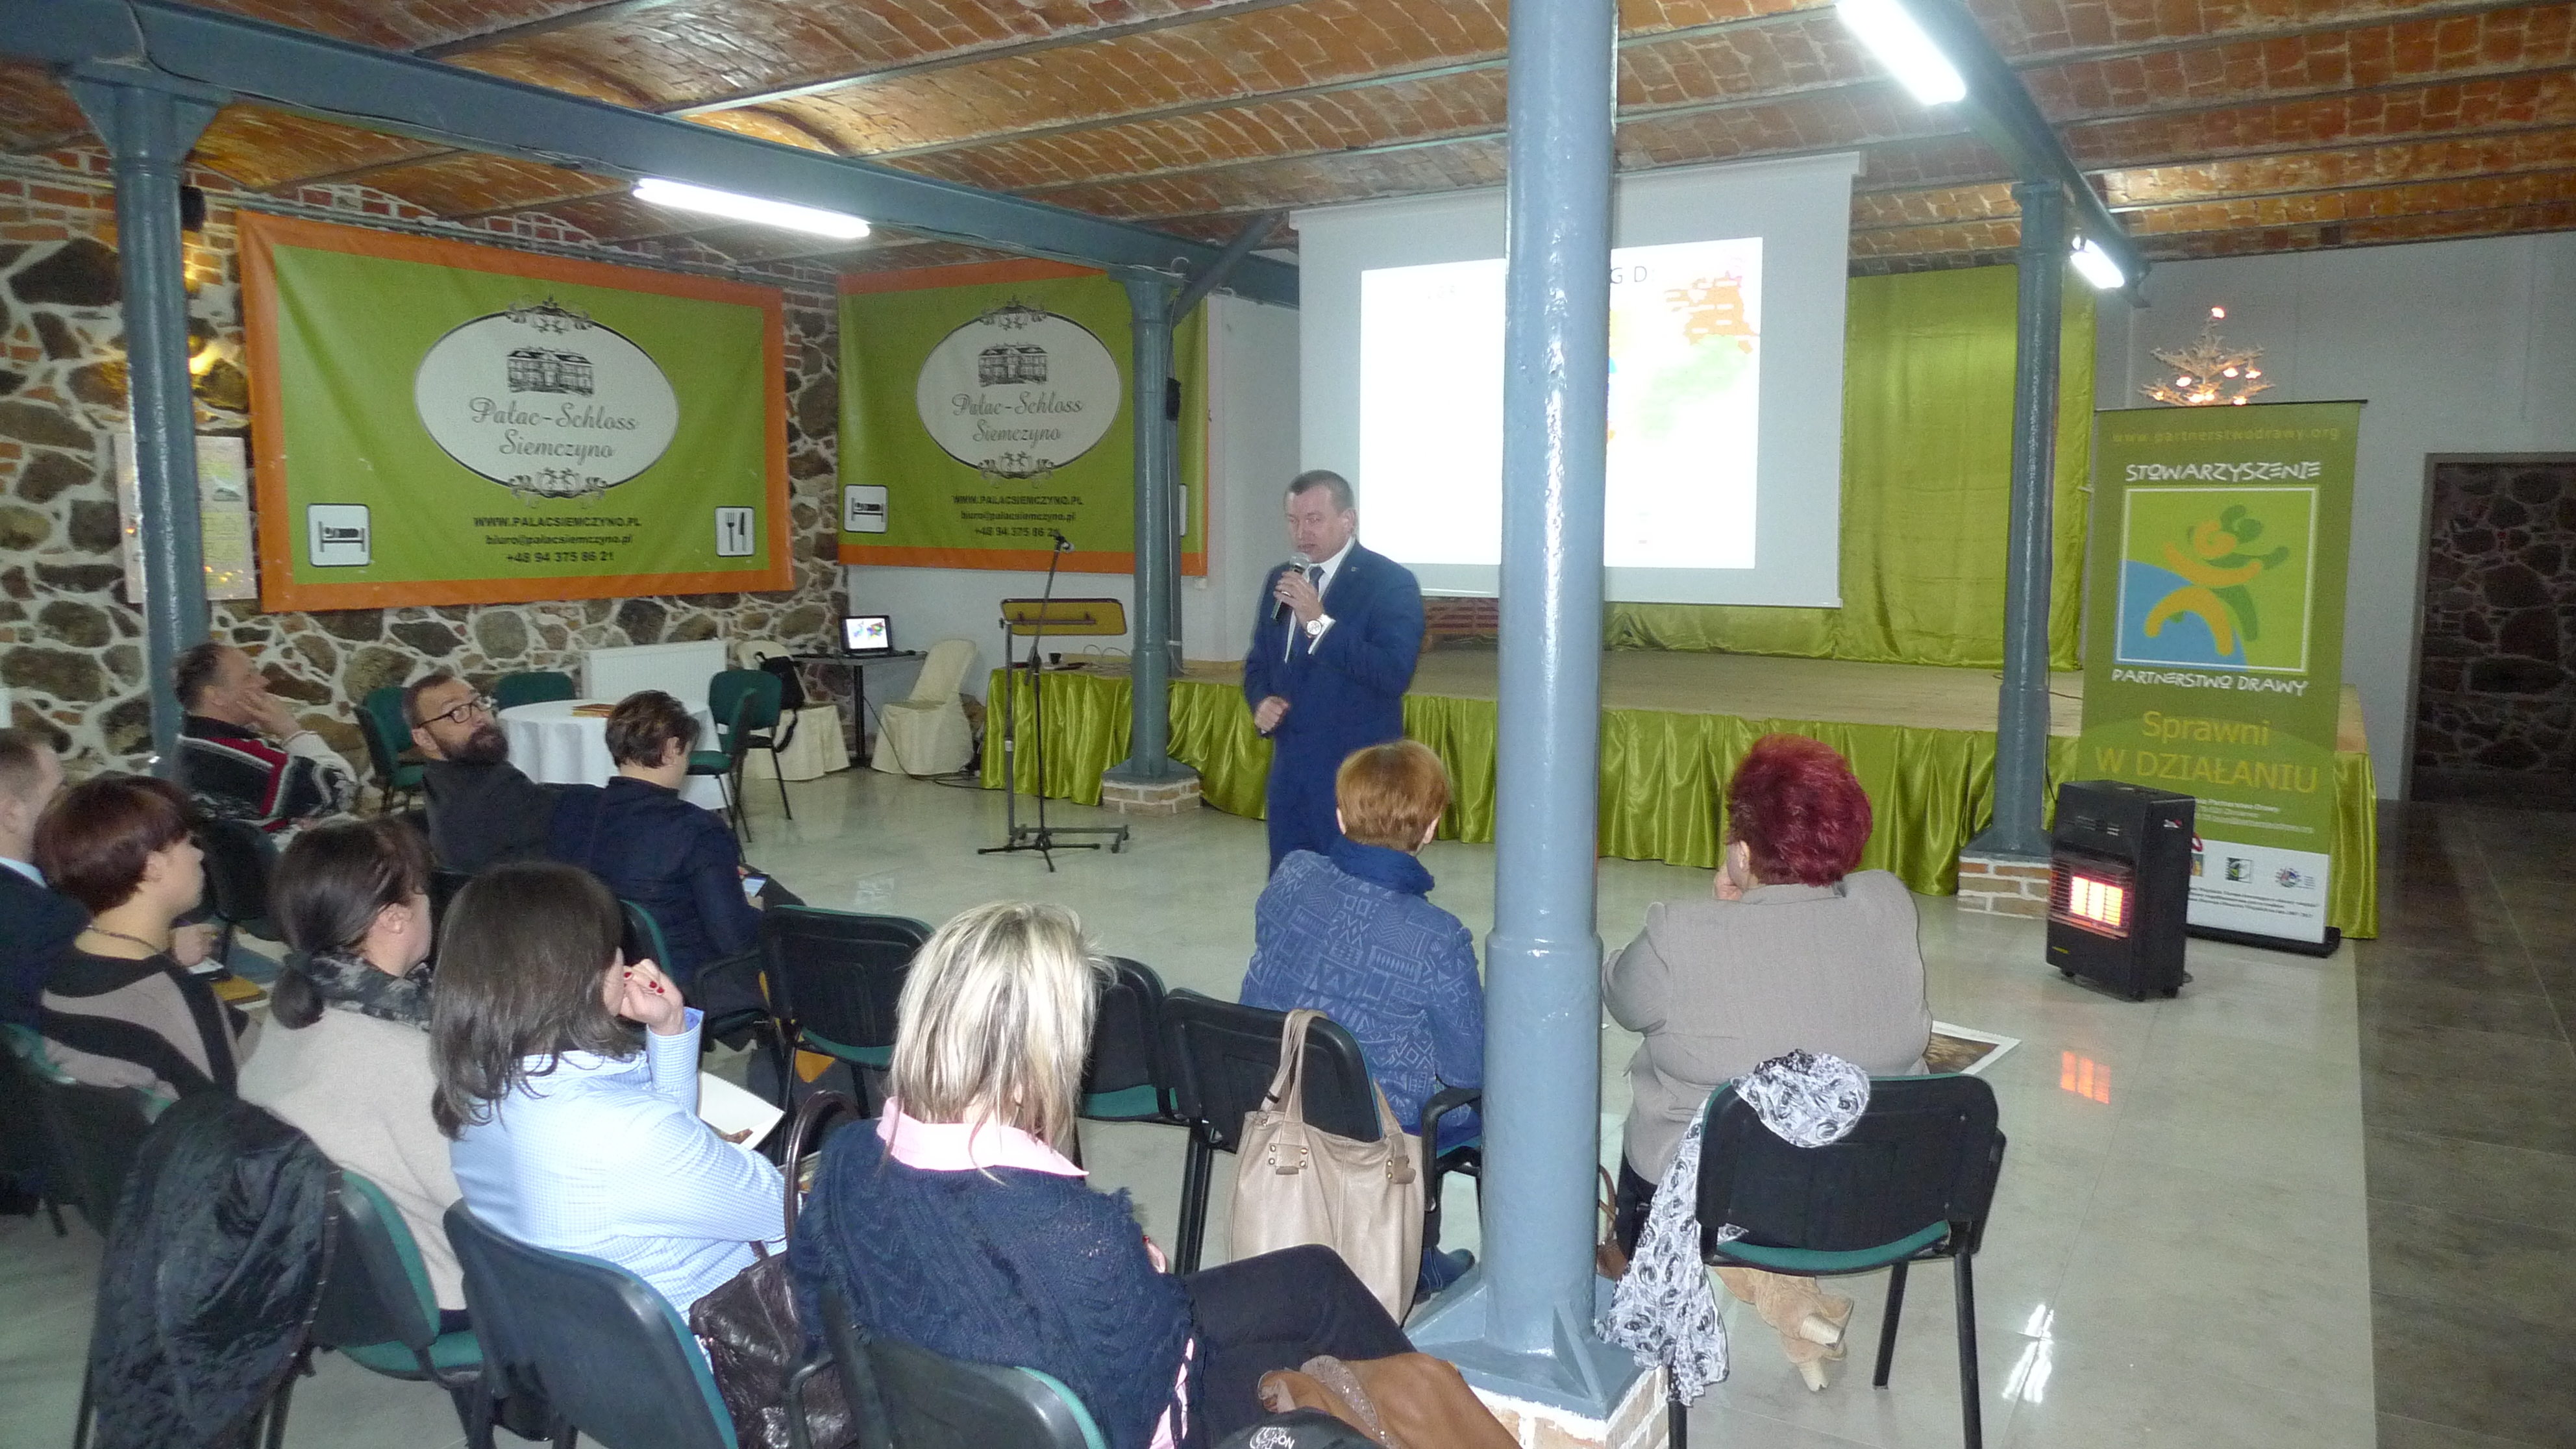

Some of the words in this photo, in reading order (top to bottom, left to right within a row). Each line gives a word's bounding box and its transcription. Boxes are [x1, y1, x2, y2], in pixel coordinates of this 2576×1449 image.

[499, 428, 613, 465] Siemczyno
[972, 419, 1061, 449] Siemczyno
[2125, 462, 2321, 482] STOWARZYSZENIE
[507, 553, 530, 563] +48
[534, 552, 551, 562] 94
[554, 552, 578, 562] 375
[601, 551, 613, 561] 21
[2111, 669, 2231, 689] PARTNERSTWO
[2237, 676, 2309, 697] DRAWY
[2143, 711, 2270, 746] Sprawni
[2096, 748, 2128, 774] W
[2136, 750, 2318, 793] DZIAŁANIU
